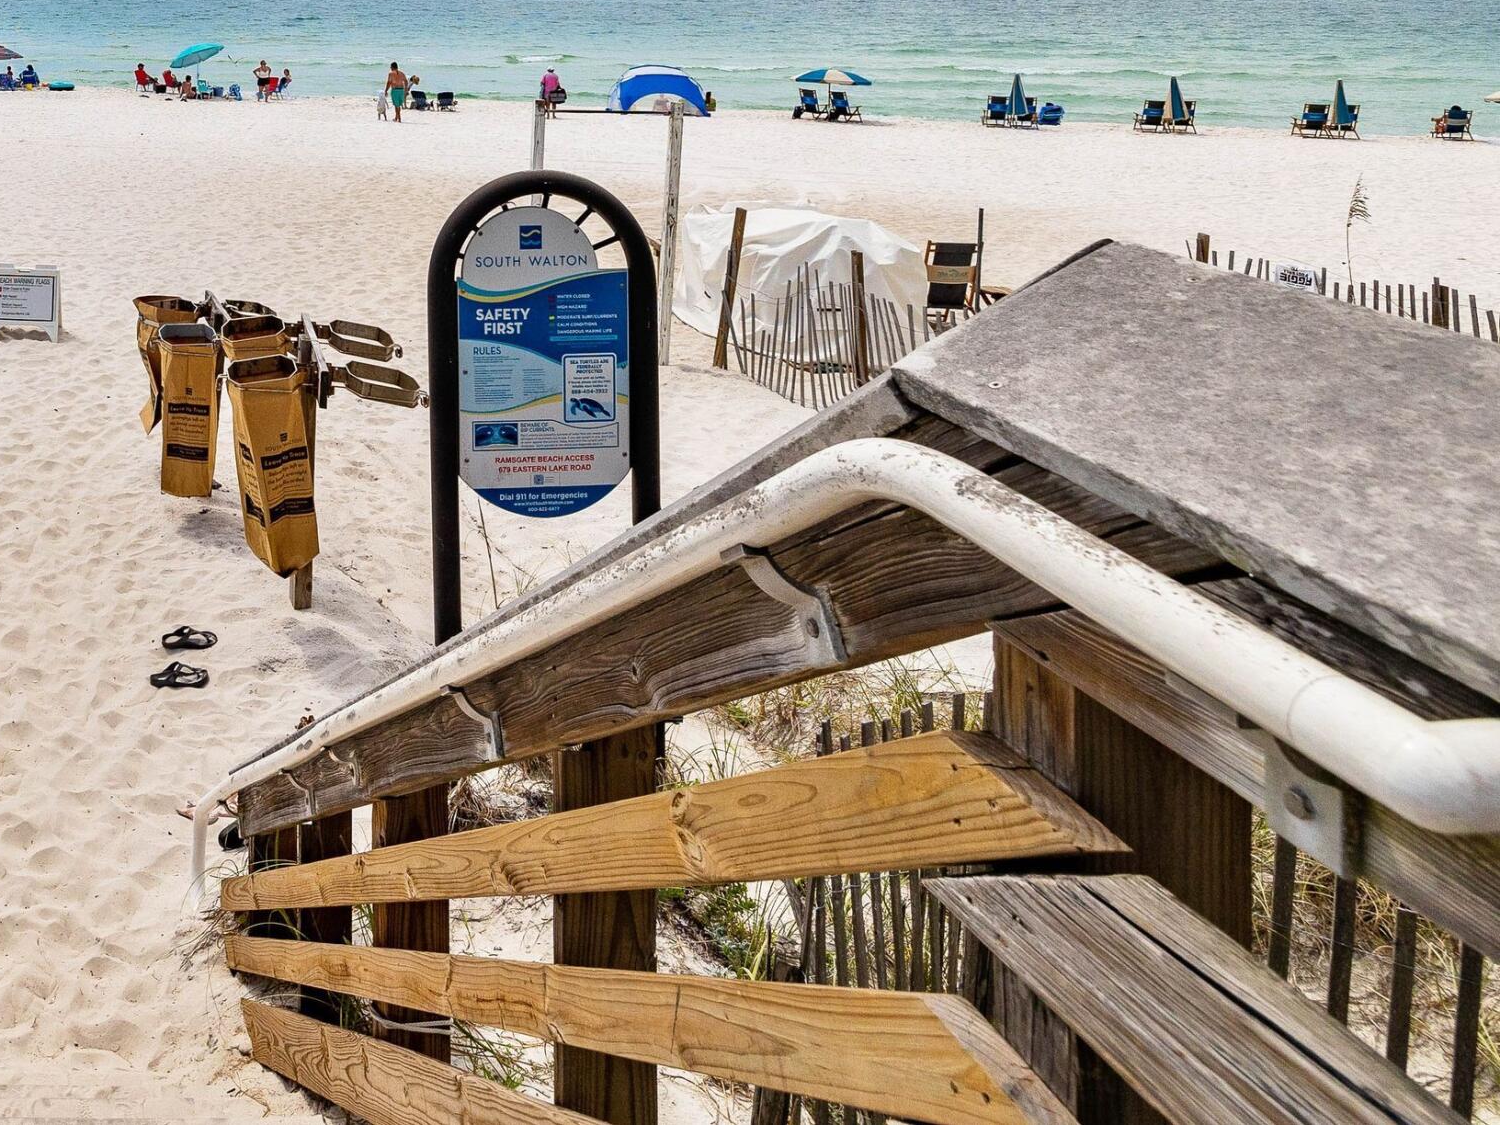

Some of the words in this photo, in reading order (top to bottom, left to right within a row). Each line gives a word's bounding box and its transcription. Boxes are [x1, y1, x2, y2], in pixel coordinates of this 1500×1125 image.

[475, 256, 521, 268] SOUTH
[528, 255, 588, 267] WALTON
[1279, 272, 1312, 286] AGGIE
[476, 307, 530, 321] SAFETY
[484, 322, 523, 335] FIRST
[473, 346, 502, 355] RULES
[264, 459, 282, 467] Leave
[495, 456, 536, 464] RAMSGATE
[537, 455, 563, 463] BEACH
[564, 454, 595, 462] ACCESS
[512, 465, 547, 473] EASTERN
[548, 464, 569, 472] LAKE
[541, 491, 588, 501] Emergencies
